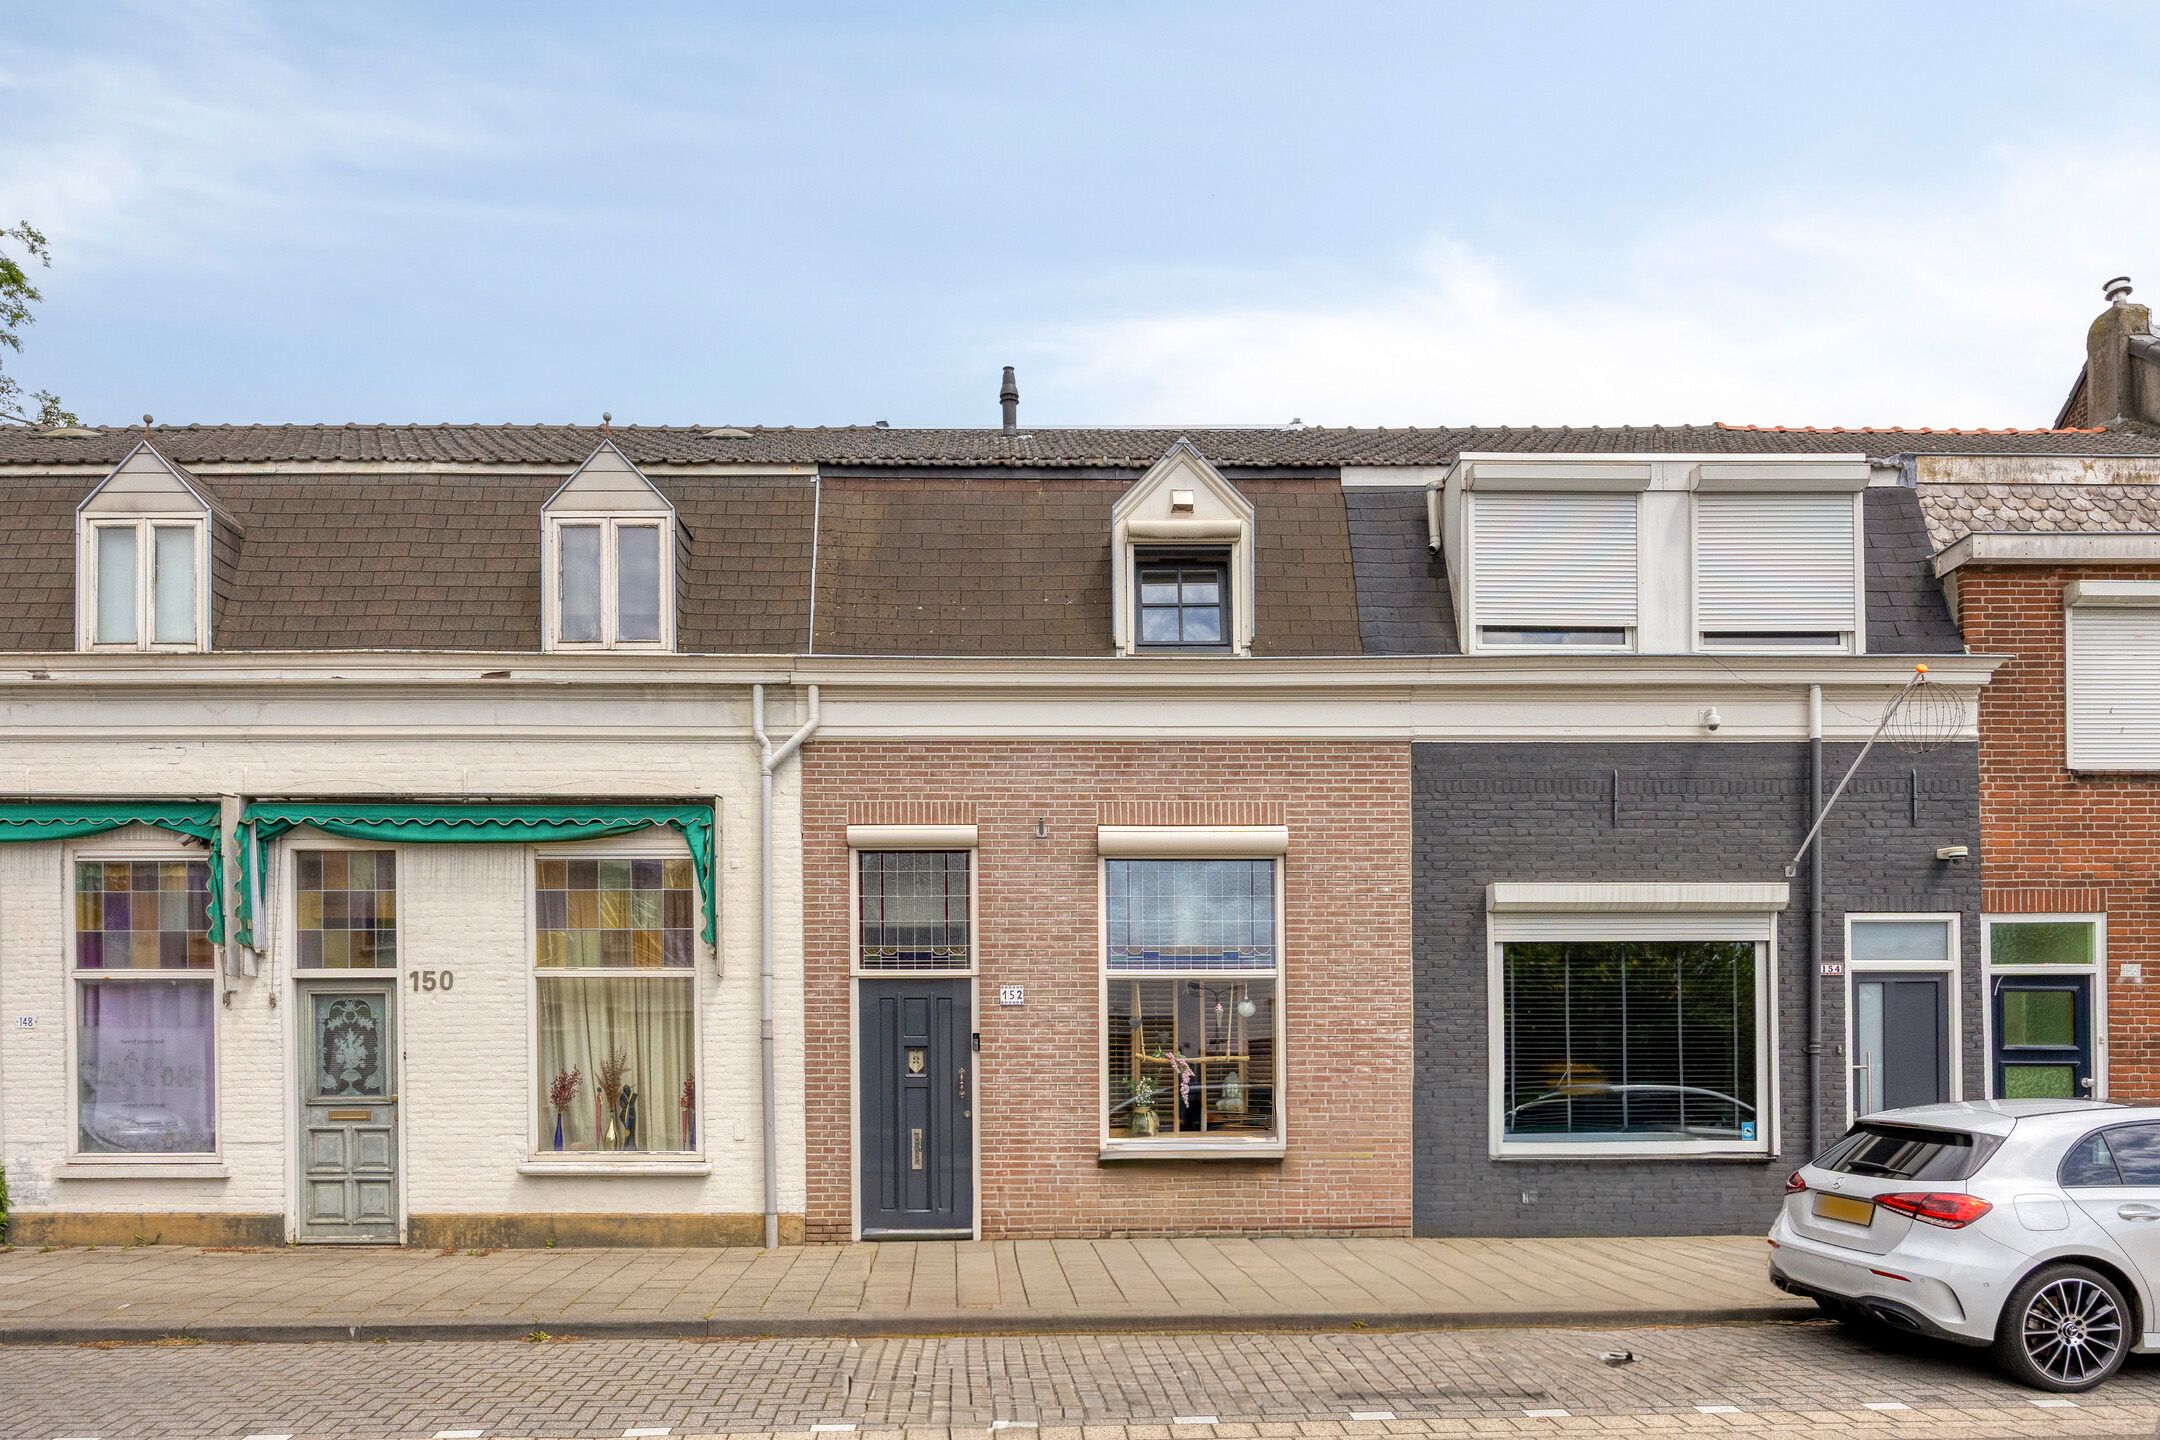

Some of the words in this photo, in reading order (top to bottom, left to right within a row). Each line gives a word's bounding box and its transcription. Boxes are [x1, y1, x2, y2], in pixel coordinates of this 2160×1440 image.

[1822, 965, 1841, 973] 154
[409, 970, 454, 992] 150
[1002, 990, 1023, 1000] 152
[19, 1017, 33, 1027] 148
